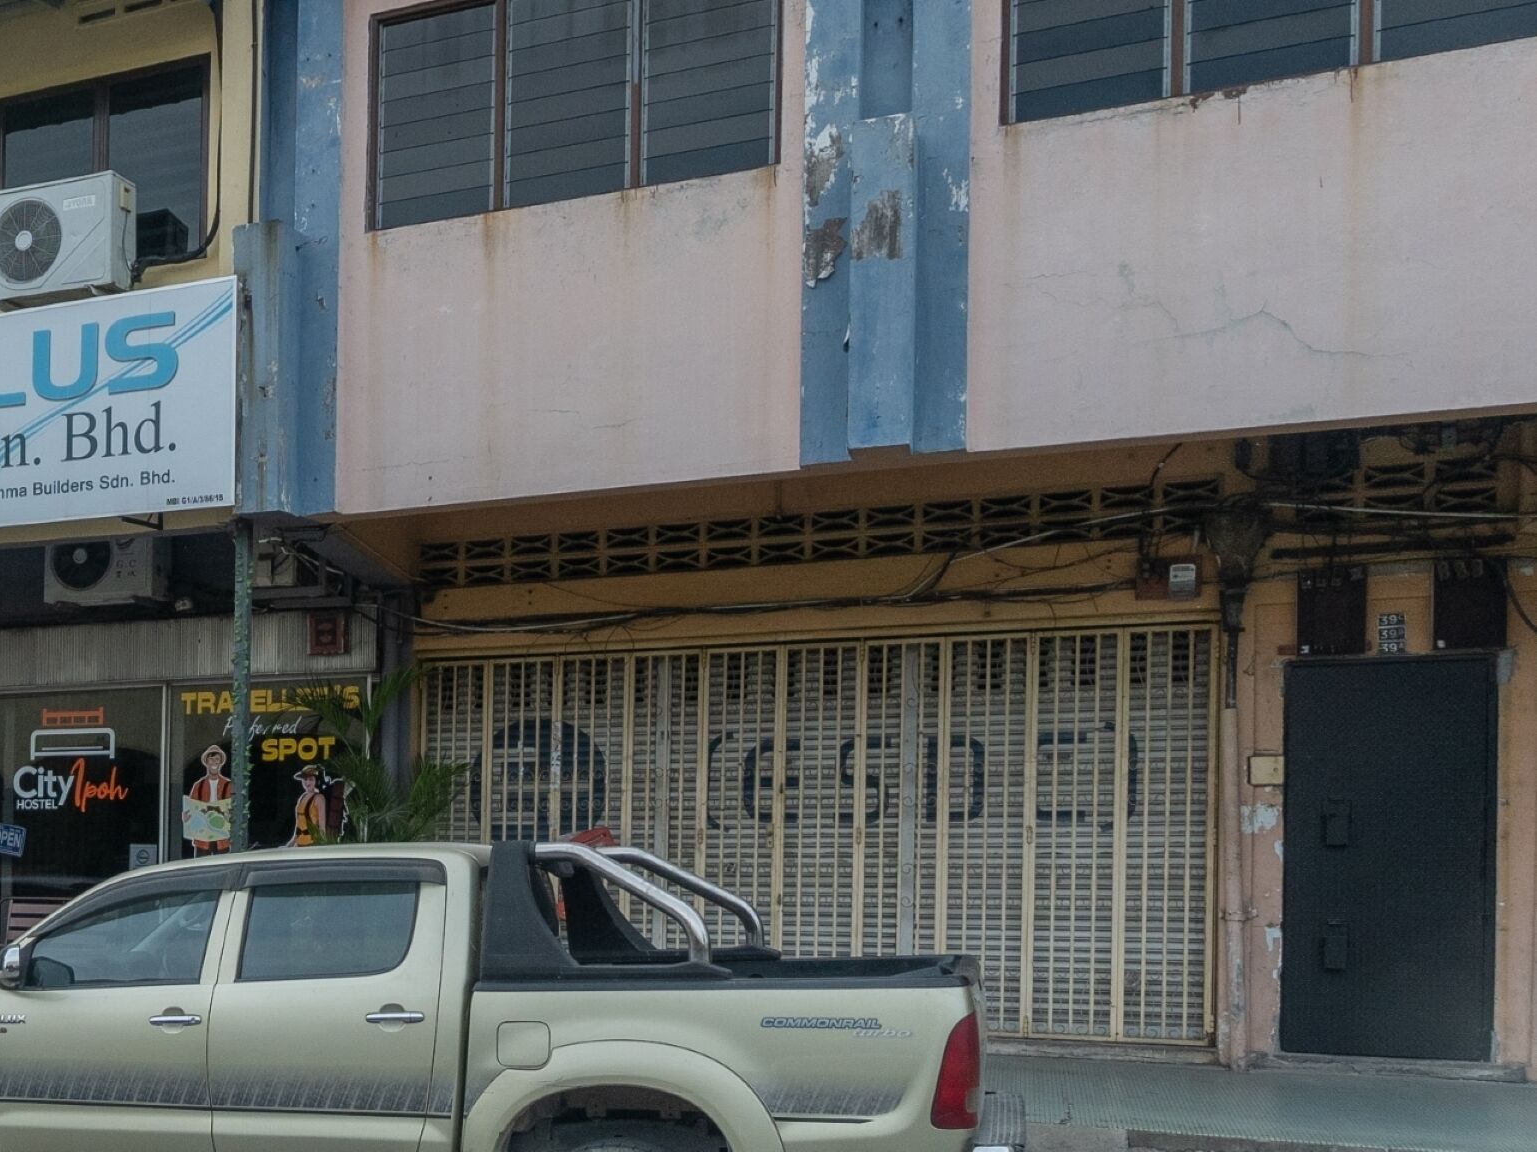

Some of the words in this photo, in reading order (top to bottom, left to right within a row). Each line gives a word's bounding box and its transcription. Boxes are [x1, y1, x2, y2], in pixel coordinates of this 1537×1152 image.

[64, 401, 178, 462] Bhd.
[32, 478, 94, 496] Builders
[99, 474, 134, 489] Sdn.
[140, 469, 176, 486] Bhd.
[261, 736, 336, 762] SPOT
[13, 765, 75, 806] City
[70, 757, 129, 813] Ipoh
[16, 799, 58, 810] HOSTEL
[760, 1017, 883, 1030] COMMONRAIL
[852, 1028, 913, 1039] turbo
